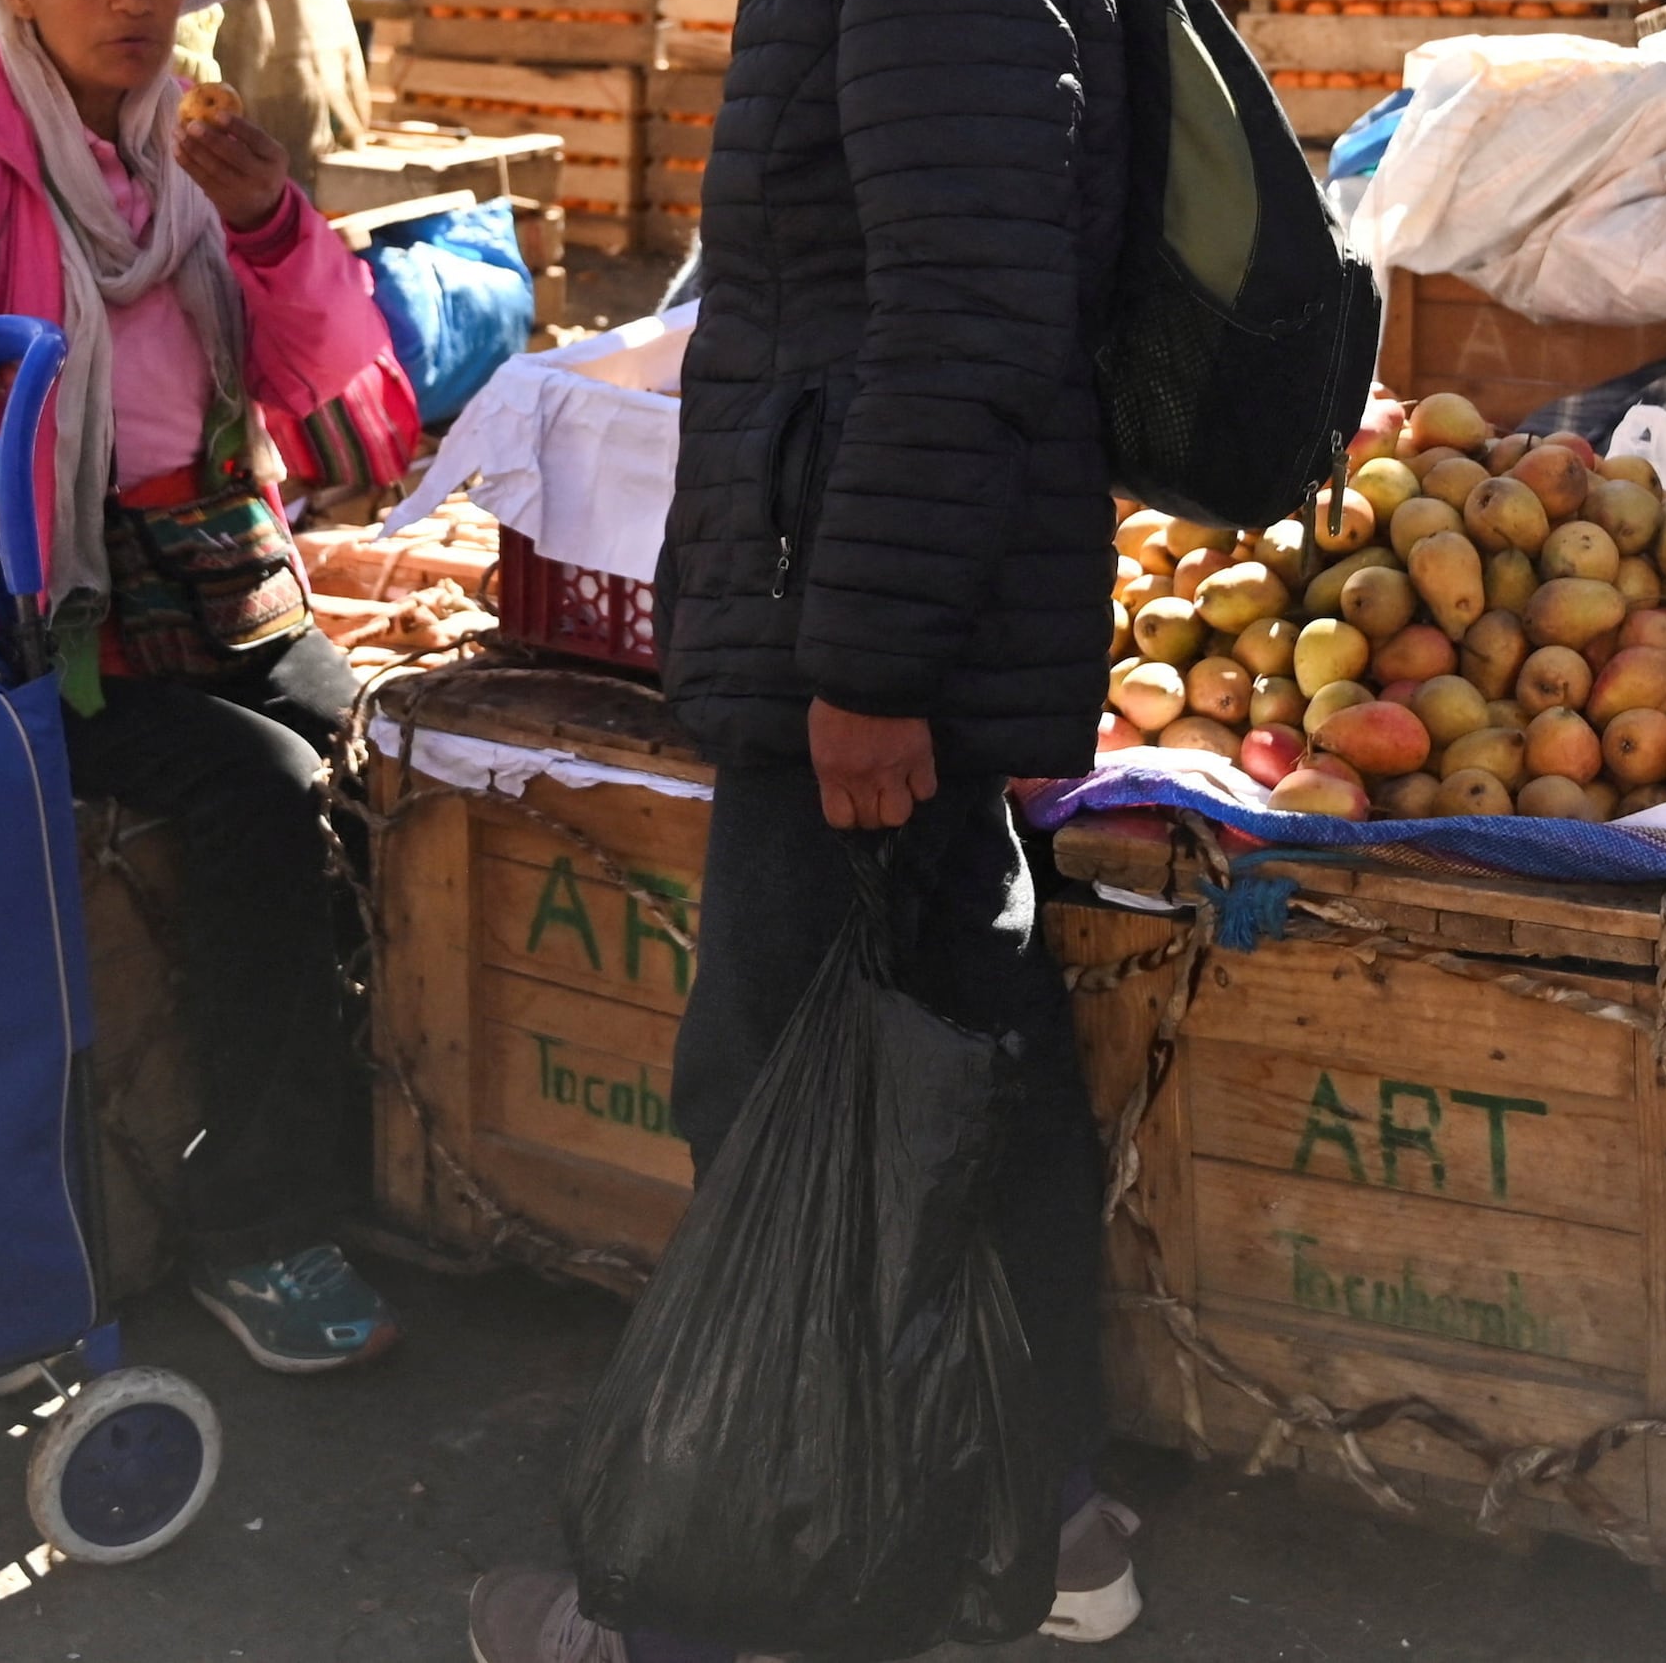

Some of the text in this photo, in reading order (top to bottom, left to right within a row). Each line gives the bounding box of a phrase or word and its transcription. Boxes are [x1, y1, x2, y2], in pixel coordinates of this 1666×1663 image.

[527, 856, 691, 995] AR
[530, 1034, 681, 1139] Tacob
[1292, 1070, 1549, 1201] ART
